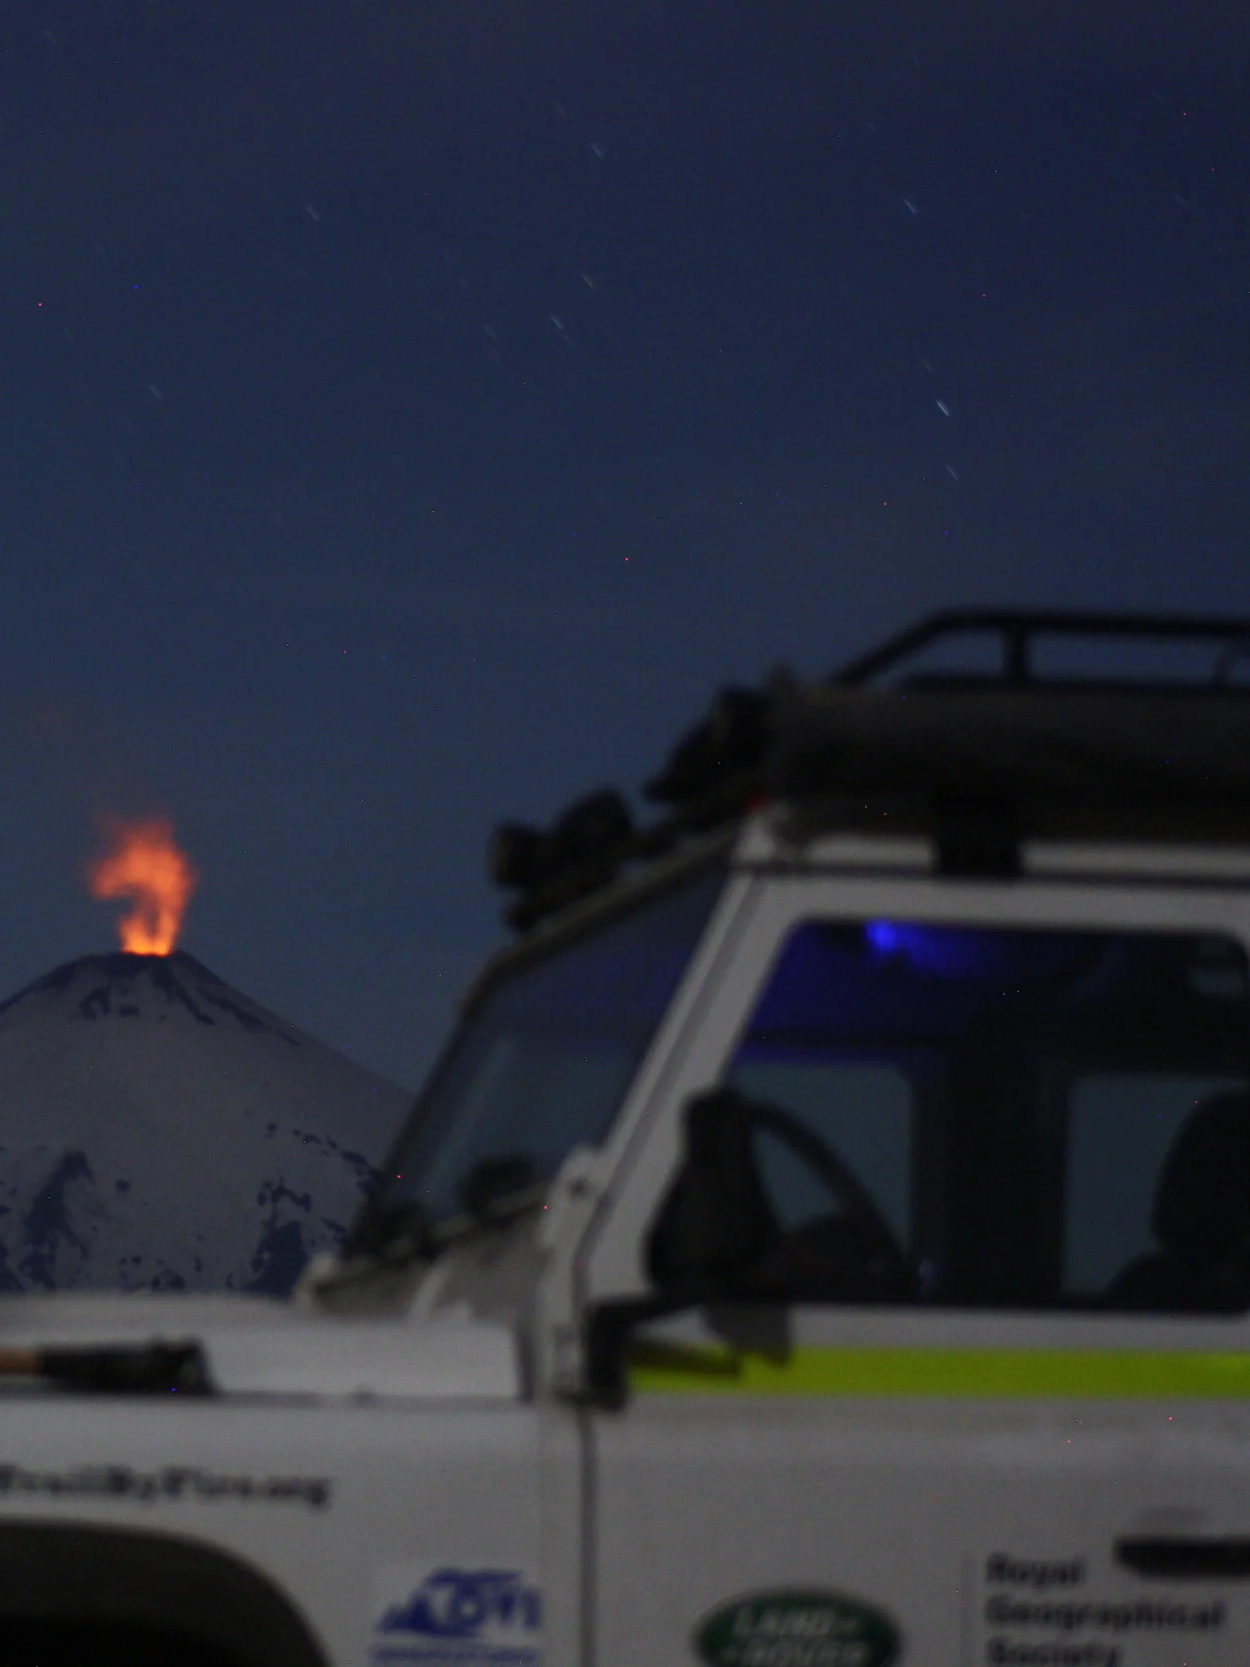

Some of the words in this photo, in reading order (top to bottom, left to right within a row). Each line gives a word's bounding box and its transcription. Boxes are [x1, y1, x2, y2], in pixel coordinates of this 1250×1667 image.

[987, 1555, 1083, 1586] Royal
[730, 1606, 838, 1637] LAND
[987, 1602, 1225, 1635] Geographical
[988, 1639, 1120, 1667] Society
